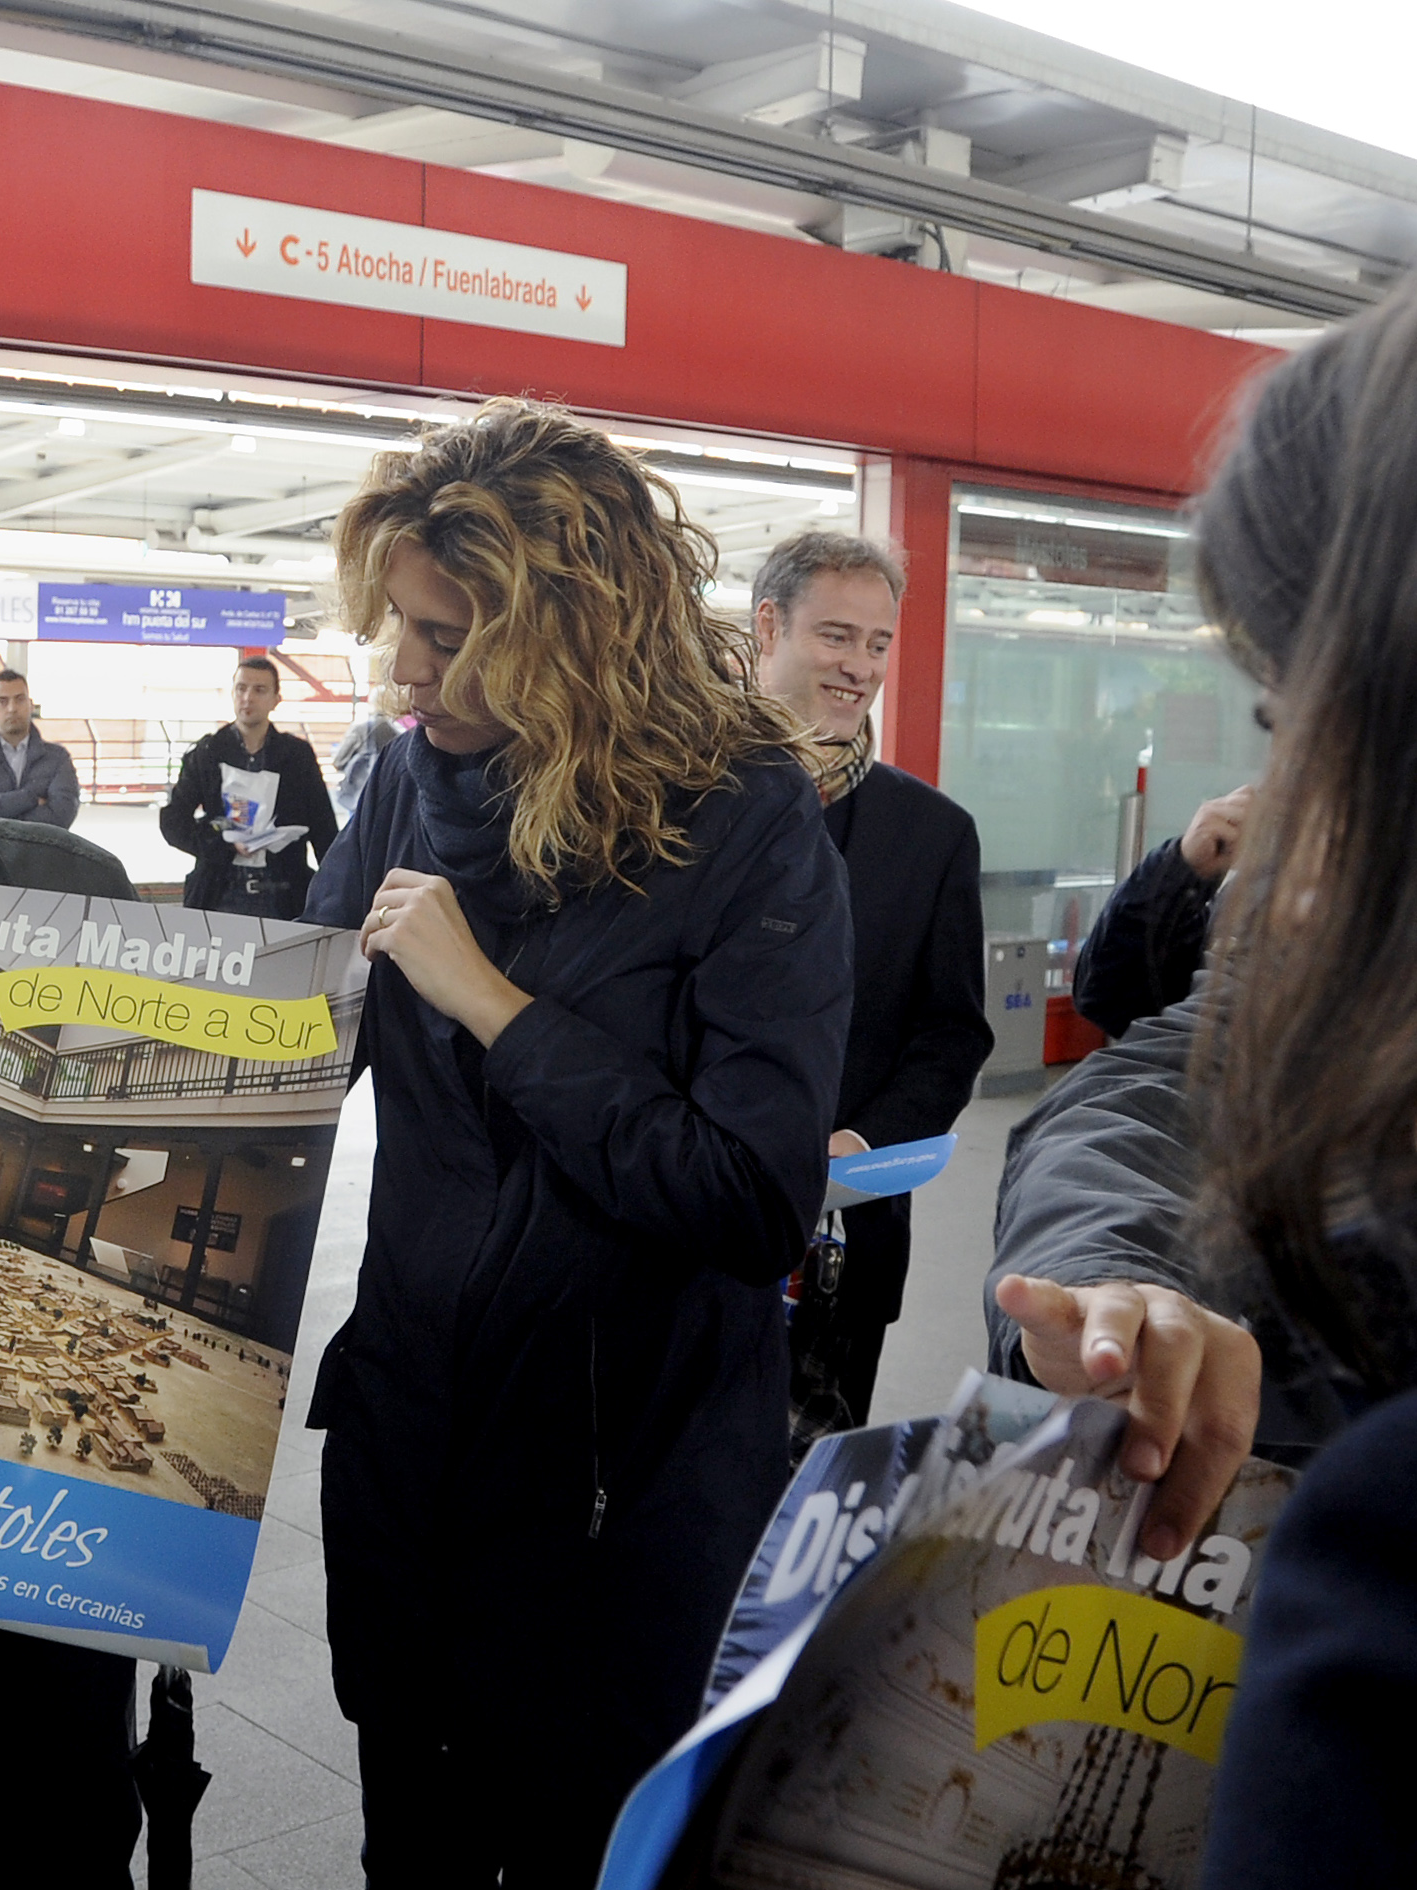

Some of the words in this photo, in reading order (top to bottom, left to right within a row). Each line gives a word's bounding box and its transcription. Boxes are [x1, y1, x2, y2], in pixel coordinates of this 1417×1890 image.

[337, 244, 413, 285] Atocha
[433, 260, 557, 307] Fuenlabrada
[76, 921, 257, 986] Madrid
[8, 973, 63, 1012] de
[77, 979, 190, 1032] Norte
[203, 1009, 229, 1039] a
[245, 1004, 323, 1050] Sur
[13, 1579, 40, 1600] en
[45, 1584, 145, 1630] Cercanías
[997, 1602, 1071, 1694] de
